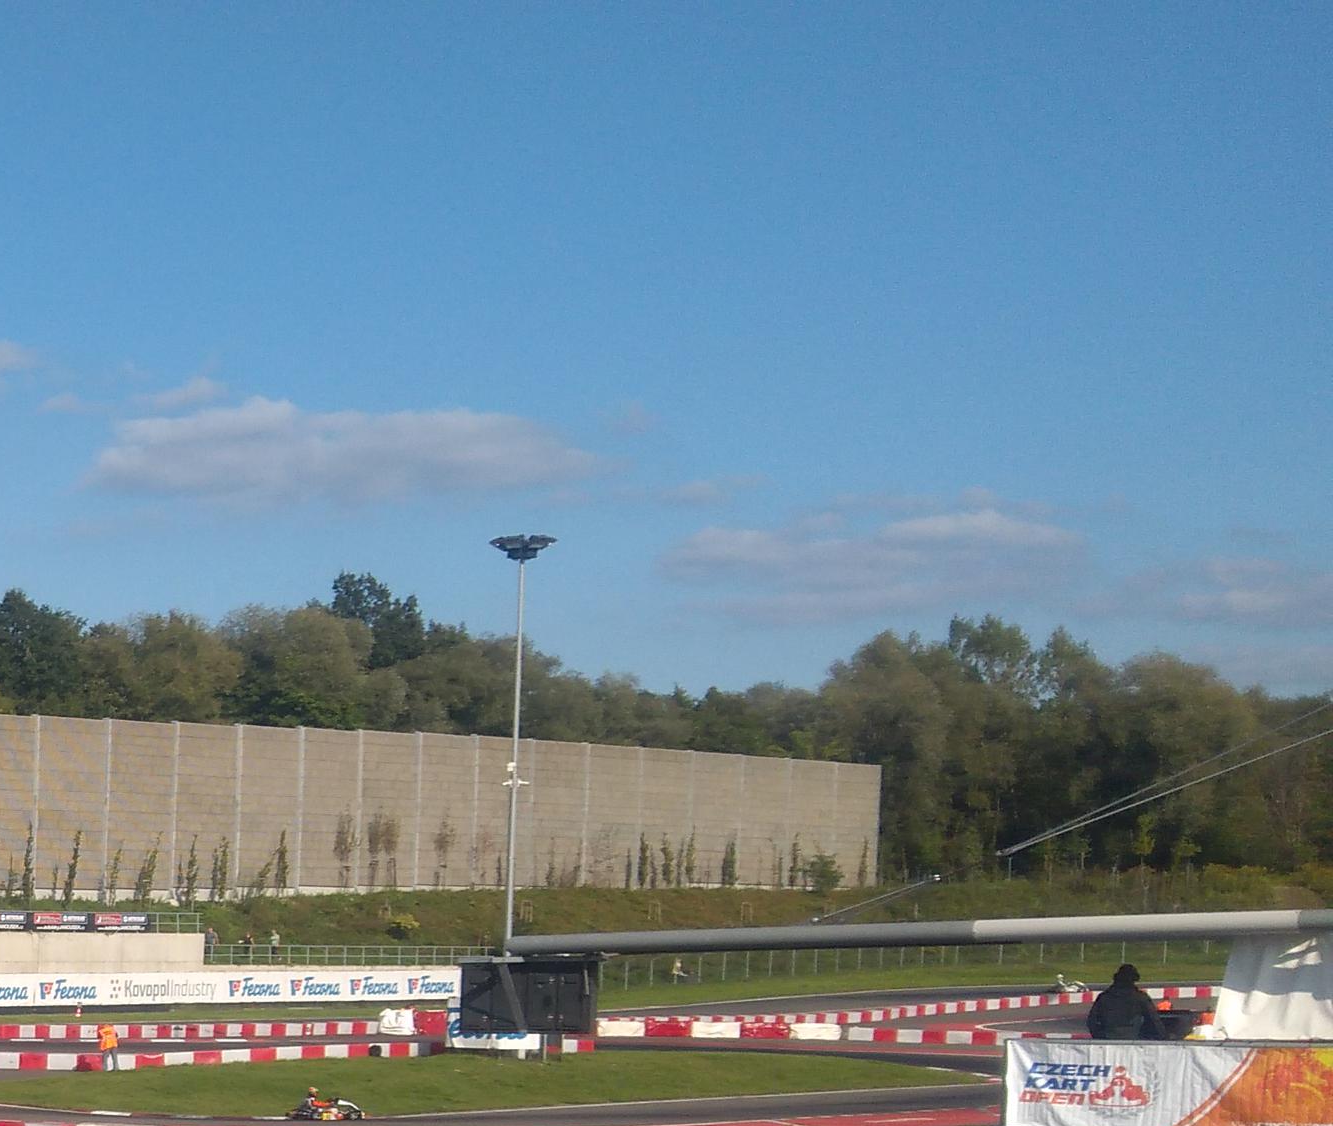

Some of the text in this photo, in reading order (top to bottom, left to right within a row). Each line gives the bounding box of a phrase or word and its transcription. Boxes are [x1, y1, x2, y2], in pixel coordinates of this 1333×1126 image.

[52, 979, 97, 999] Ferona
[242, 976, 281, 997] Ferona
[301, 976, 340, 996] Ferona
[360, 976, 399, 995] Ferona
[418, 975, 455, 994] Ferona
[1029, 1062, 1111, 1077] CZECH
[1024, 1077, 1095, 1091] KART
[1019, 1090, 1085, 1106] OPEN
